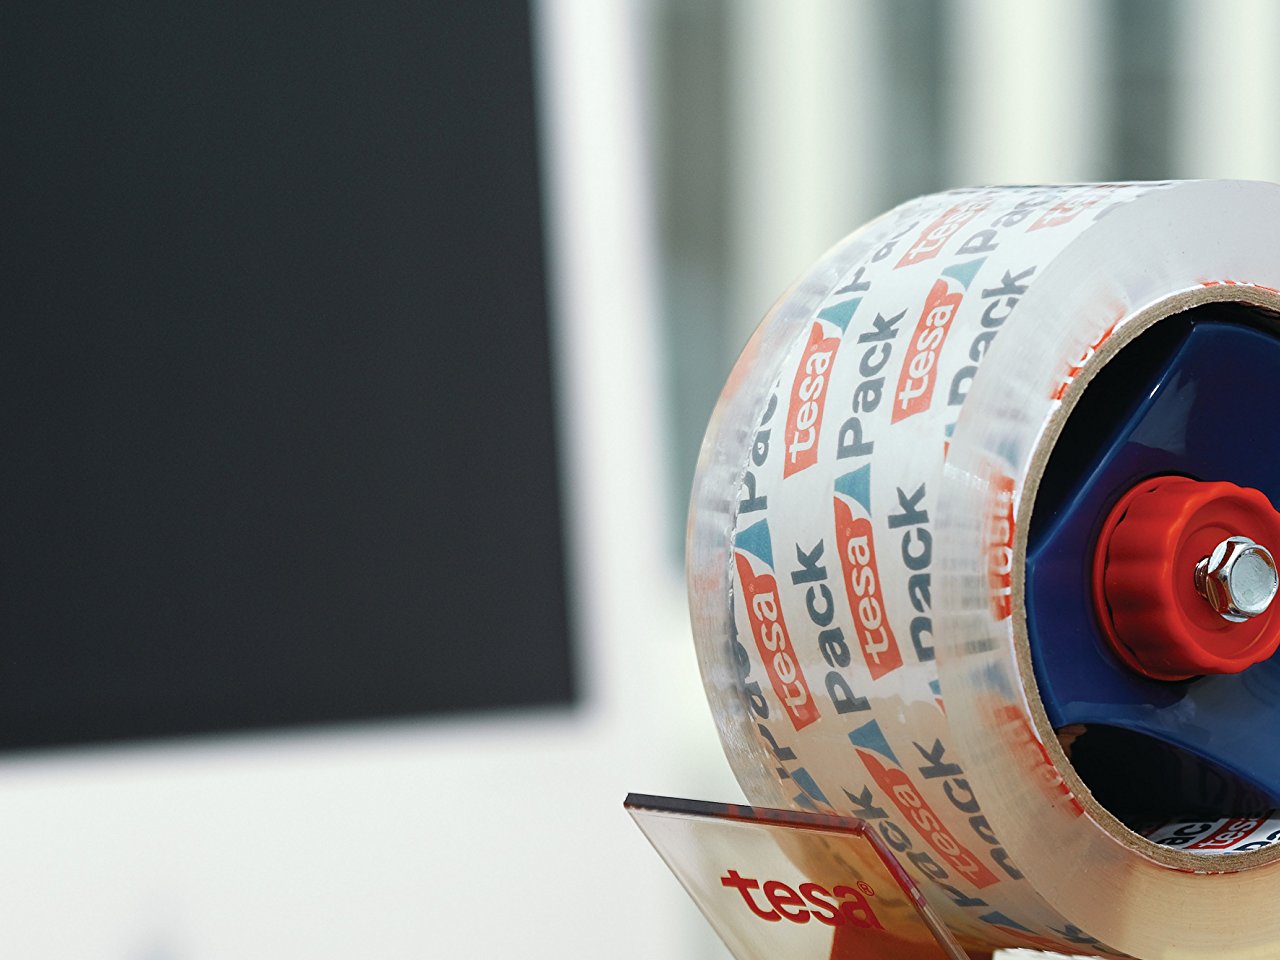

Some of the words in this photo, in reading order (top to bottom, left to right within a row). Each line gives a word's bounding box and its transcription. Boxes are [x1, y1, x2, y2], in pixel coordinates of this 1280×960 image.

[789, 350, 833, 463] tesa
[837, 308, 908, 460] Pack
[899, 304, 954, 410] tesa
[752, 591, 808, 717] tesa
[791, 538, 871, 714] Pack
[846, 535, 888, 658] tesa
[893, 784, 980, 881] tesa
